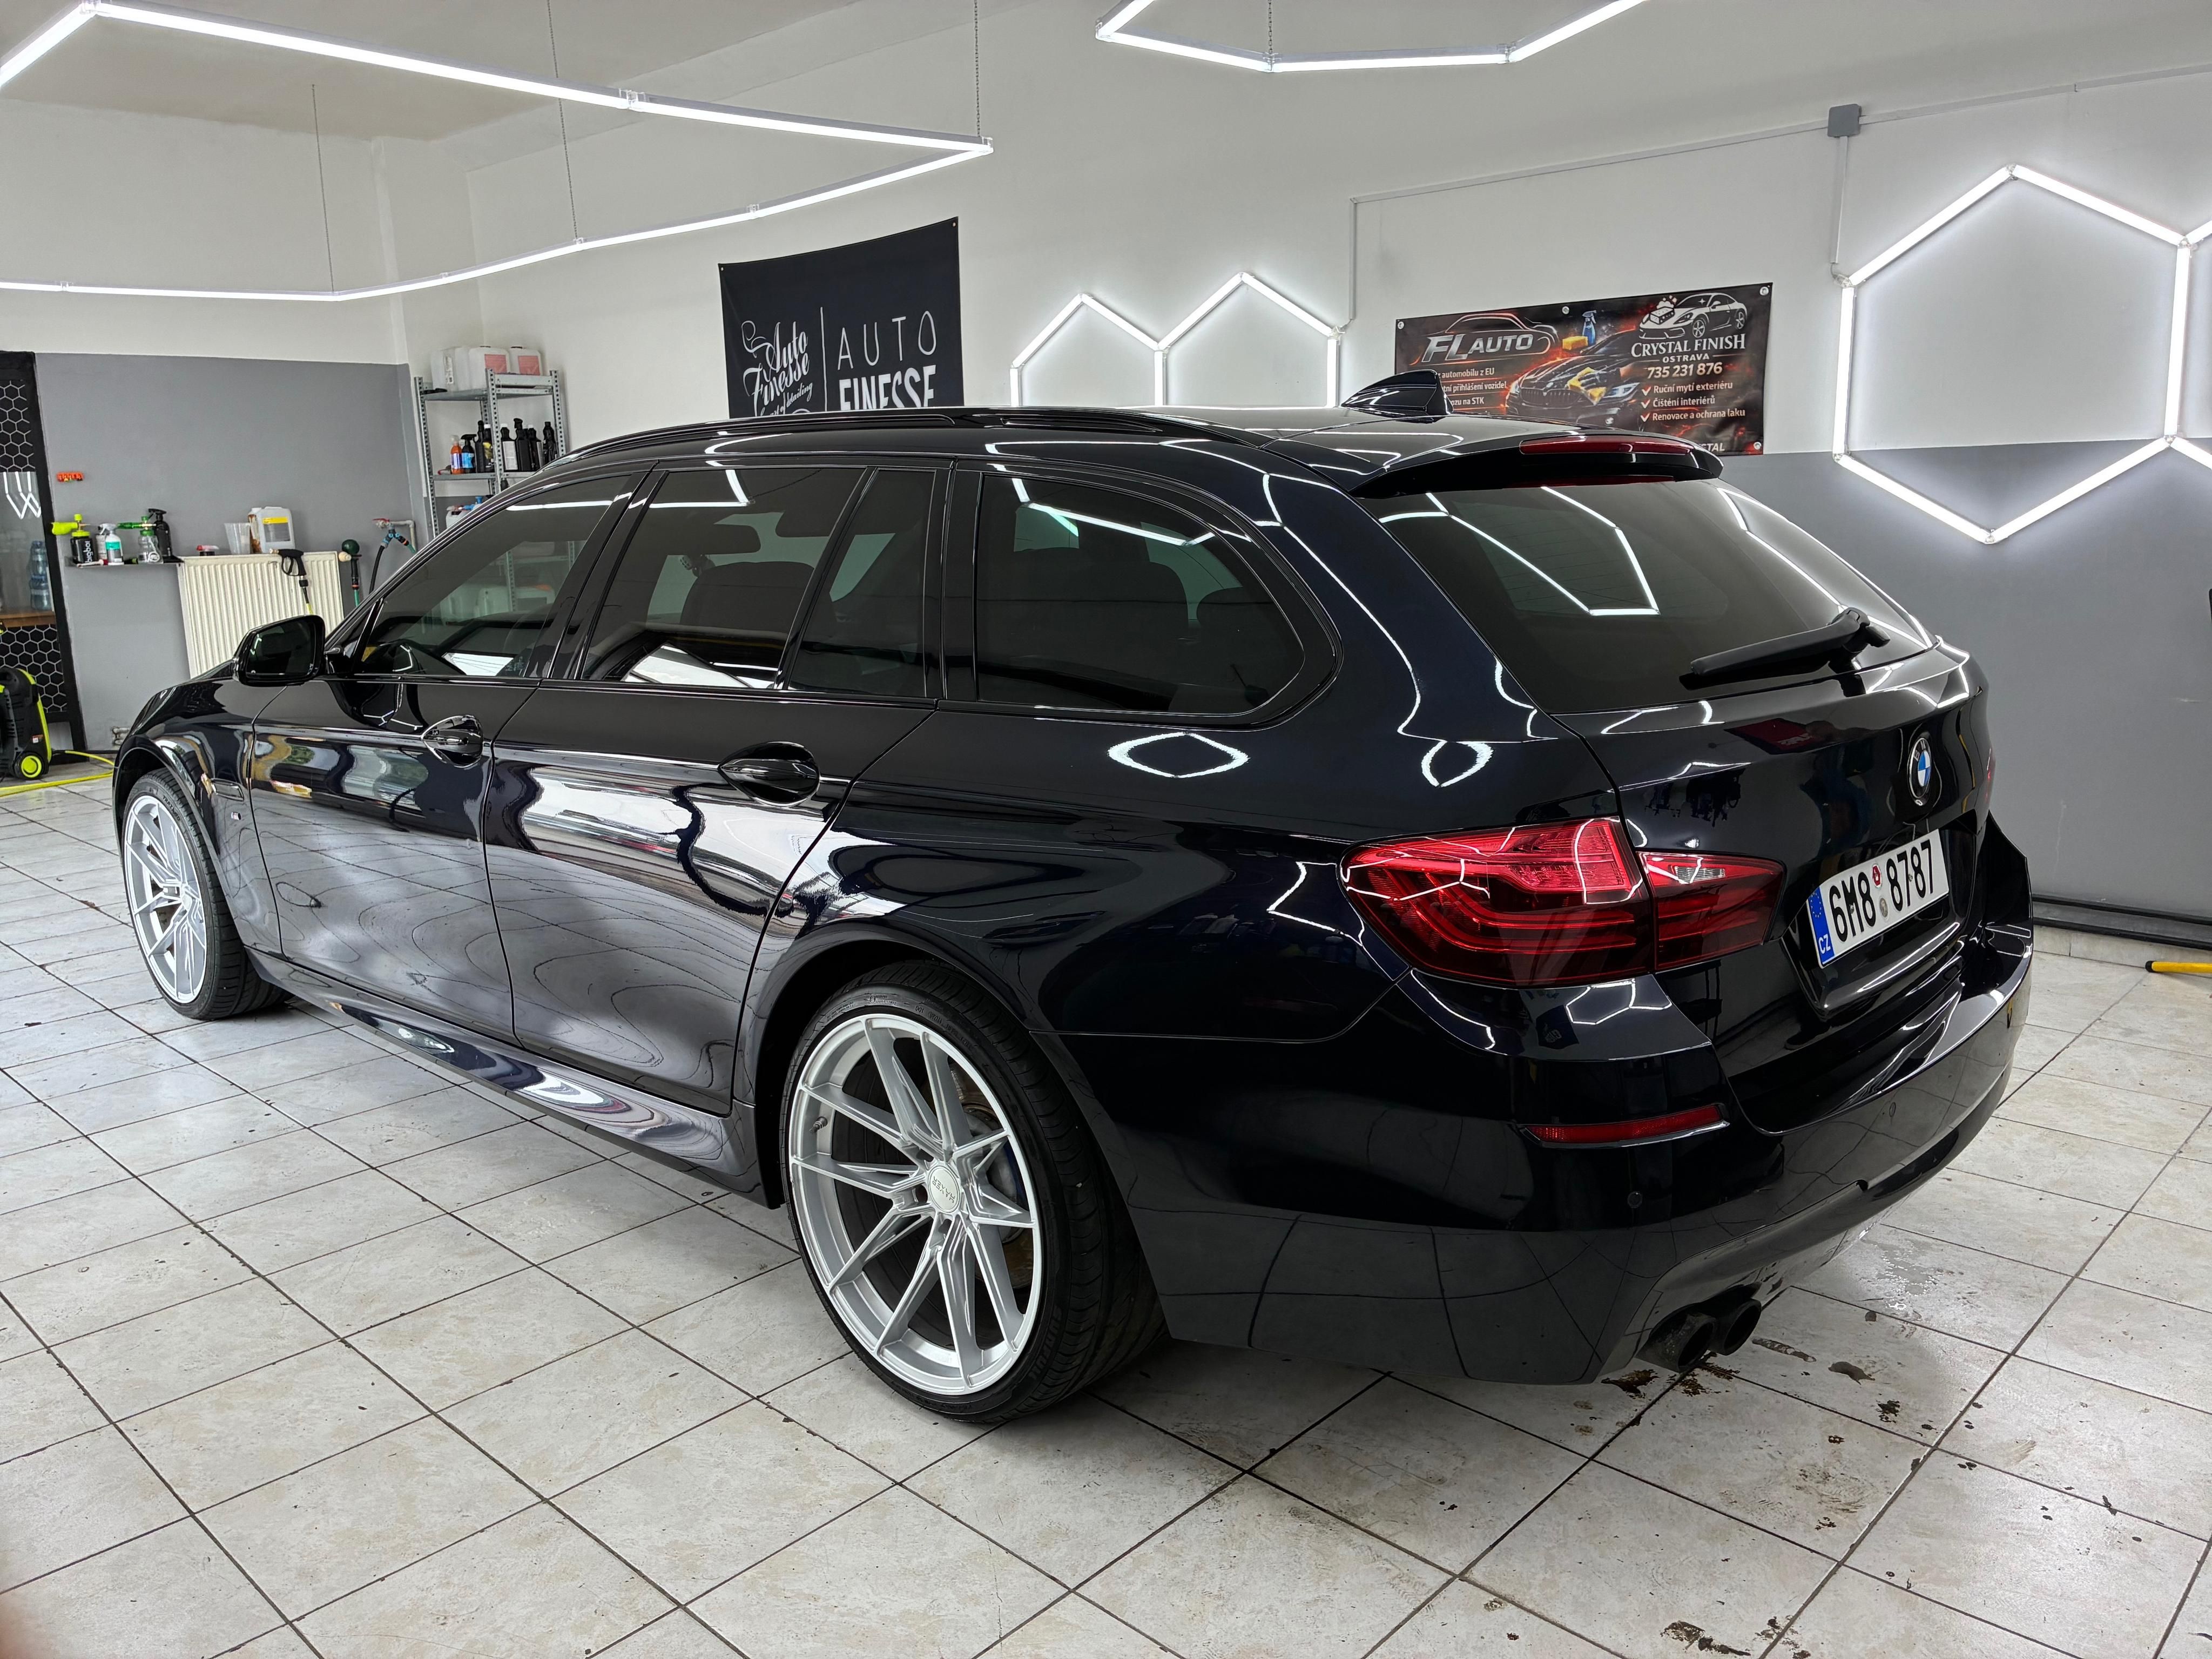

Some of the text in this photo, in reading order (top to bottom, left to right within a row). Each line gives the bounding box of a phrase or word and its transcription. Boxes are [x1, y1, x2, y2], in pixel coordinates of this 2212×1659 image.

[838, 311, 936, 370] AUTO
[1467, 334, 1534, 354] AUTO
[1631, 333, 1746, 358] CRYSTAL FINISH
[741, 320, 808, 381] Auto
[1662, 353, 1710, 363] OSTRAVA
[1485, 367, 1495, 376] EU
[1647, 362, 1723, 379] 735 231 876
[743, 352, 810, 417] Finesse
[1485, 380, 1507, 390] vozidel
[1654, 383, 1675, 394] Ruční
[1676, 382, 1695, 393] mytí
[1472, 397, 1485, 405] STK
[1653, 412, 1689, 421] Renovace
[1696, 410, 1726, 419] ochrana
[1728, 408, 1746, 417] laku
[1829, 839, 1933, 942] 6M8 8787
[1818, 934, 1831, 954] CZ
